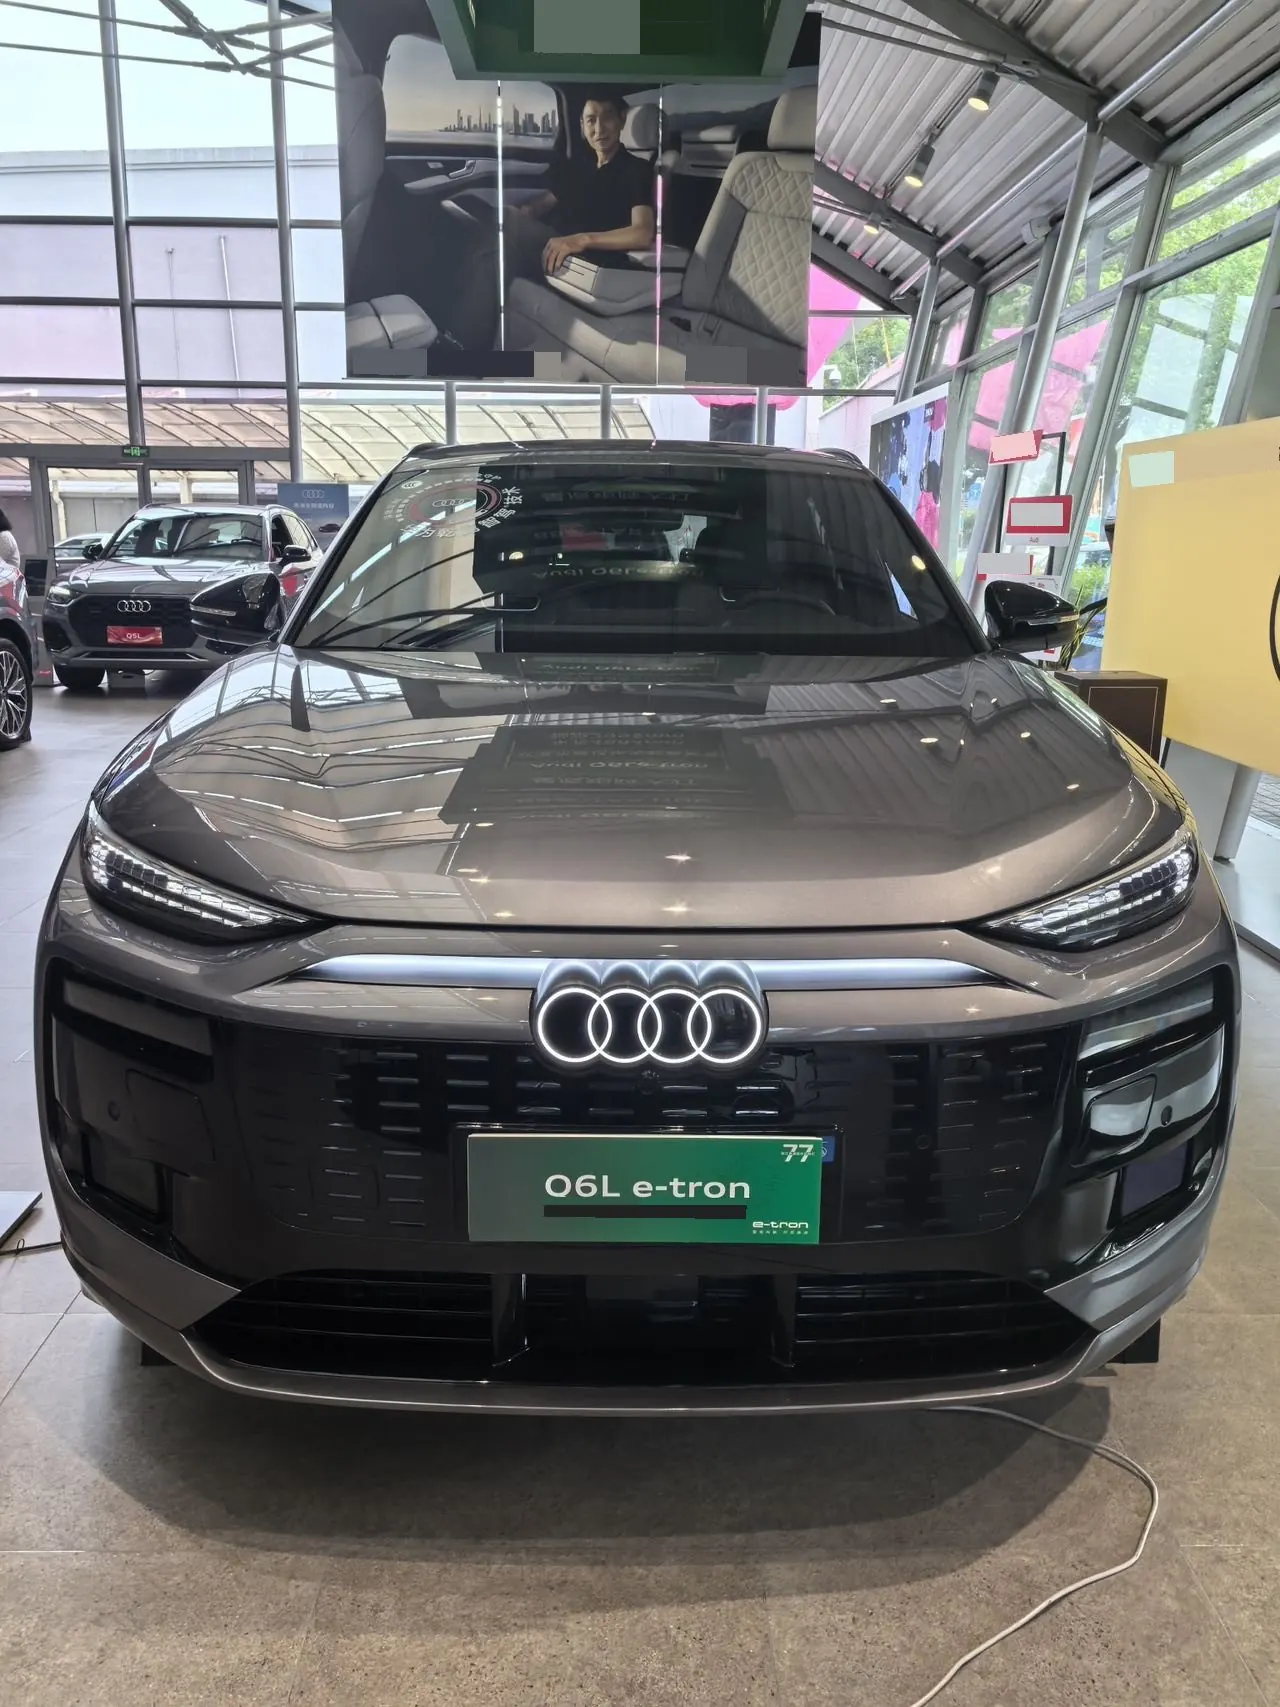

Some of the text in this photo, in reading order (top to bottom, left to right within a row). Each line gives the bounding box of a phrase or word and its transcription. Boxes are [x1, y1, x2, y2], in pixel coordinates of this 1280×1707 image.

[544, 1173, 751, 1199] Q6L e-tron
[752, 1220, 809, 1229] e-tron
